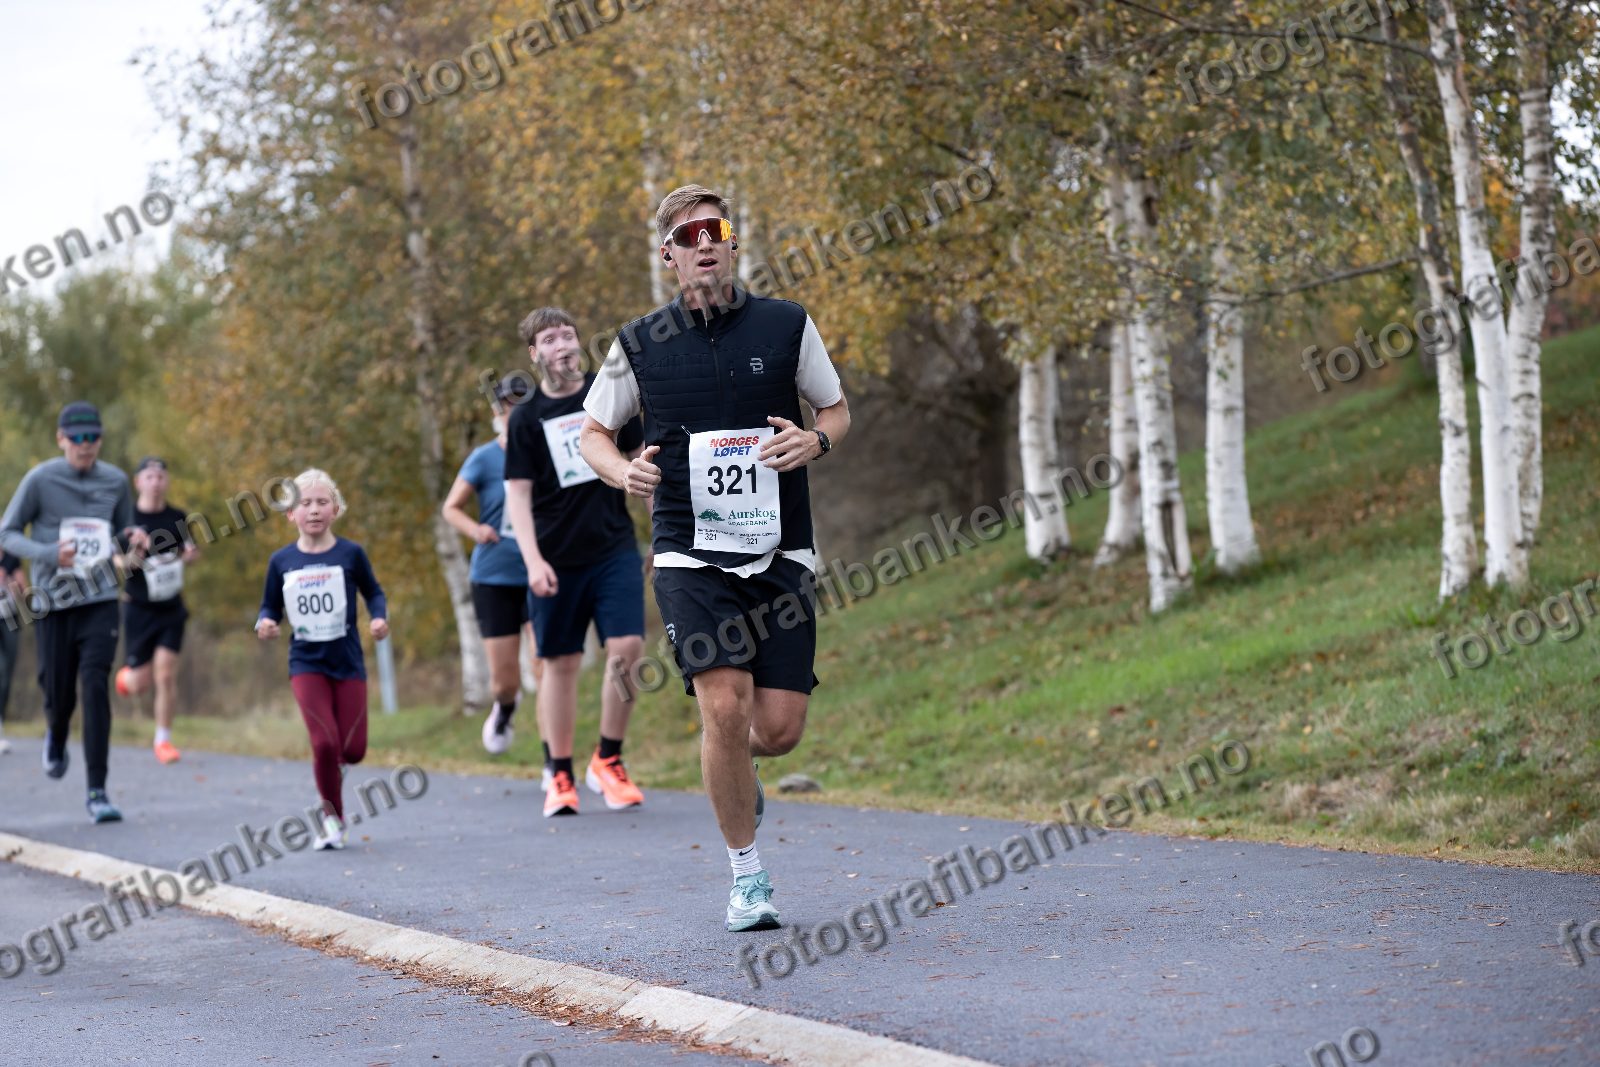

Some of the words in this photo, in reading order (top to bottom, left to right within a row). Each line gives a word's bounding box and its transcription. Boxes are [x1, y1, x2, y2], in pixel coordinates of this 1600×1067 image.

[709, 435, 760, 448] NORGES
[713, 446, 752, 457] LØPET
[707, 463, 757, 496] 321
[728, 508, 777, 520] Aurskog
[704, 533, 717, 541] 321
[745, 537, 758, 545] 321
[297, 592, 334, 616] 800
